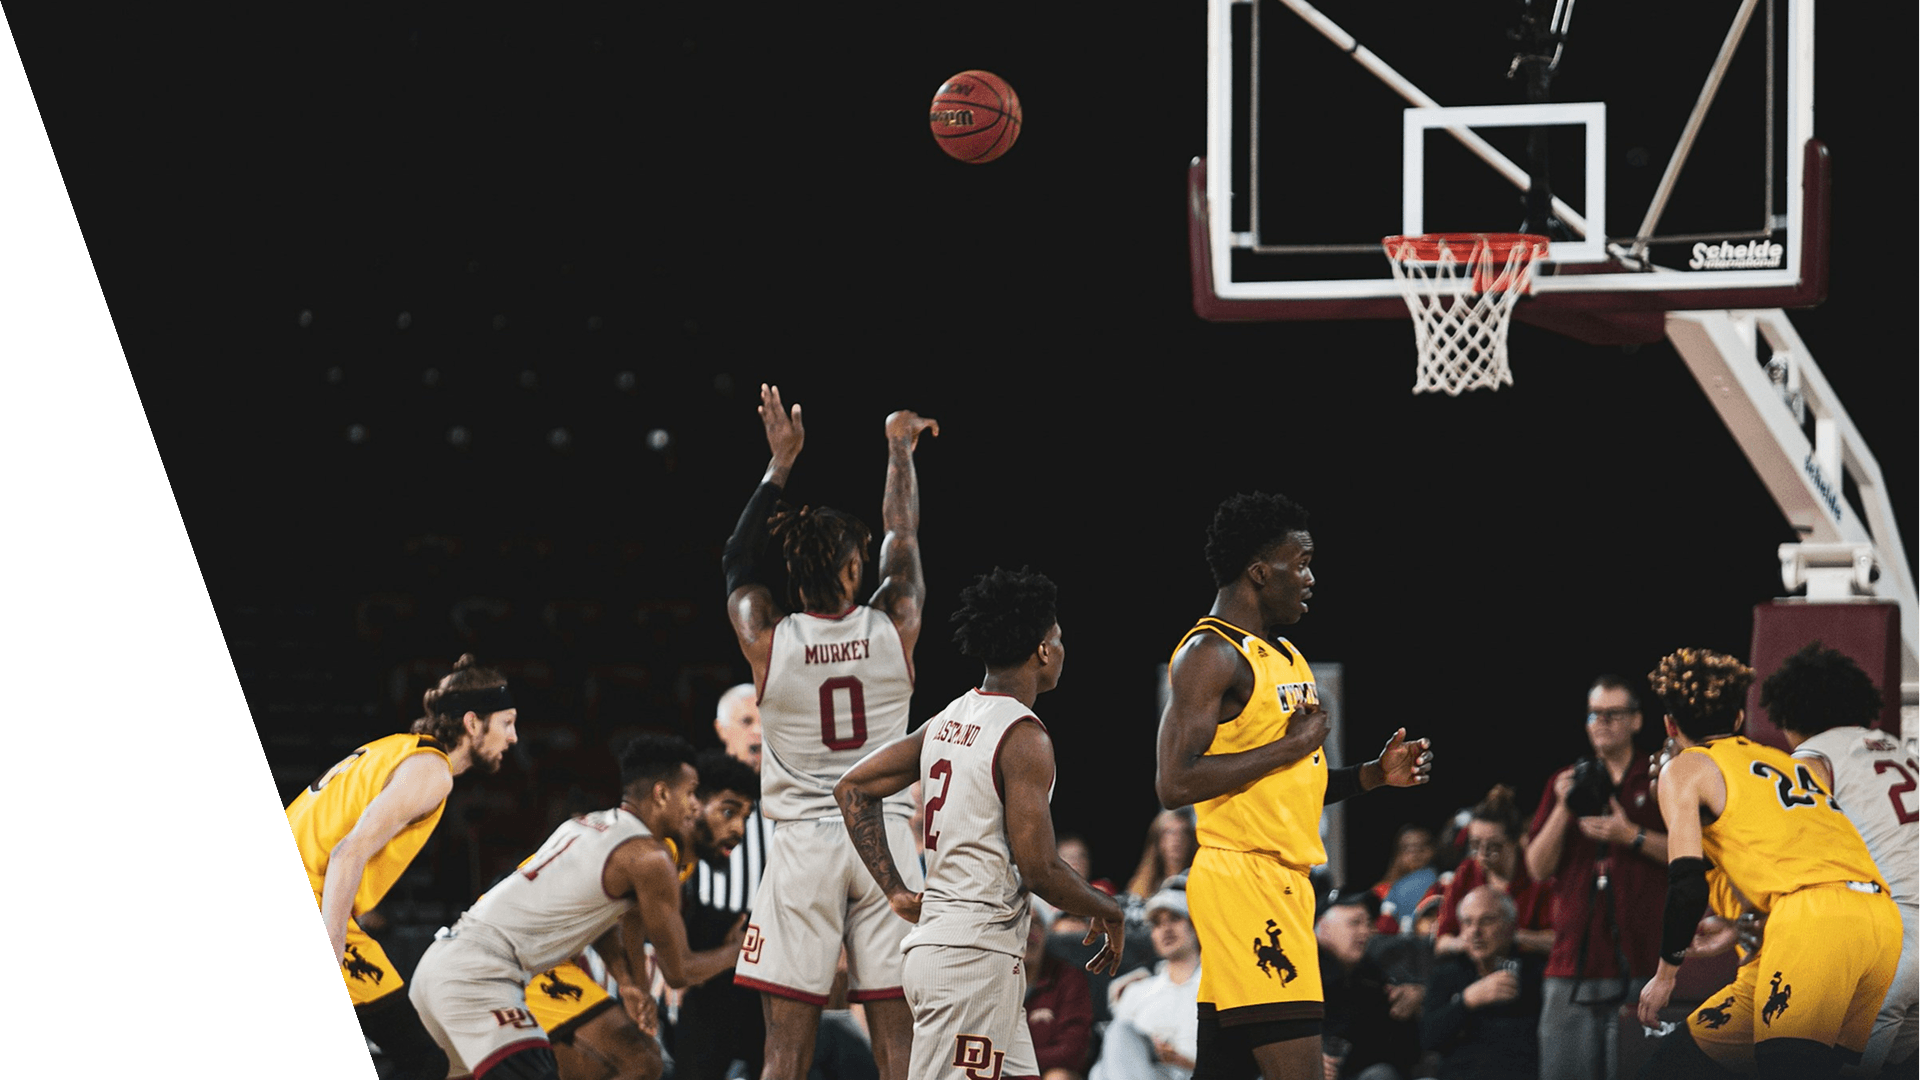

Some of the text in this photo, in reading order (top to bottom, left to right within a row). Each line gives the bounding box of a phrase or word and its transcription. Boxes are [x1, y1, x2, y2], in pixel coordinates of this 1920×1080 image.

[1689, 240, 1783, 270] Schelde
[804, 638, 870, 665] MURKEY
[819, 674, 868, 752] 0
[925, 758, 952, 851] 2
[1750, 761, 1842, 812] 24
[490, 1006, 539, 1030] DU
[953, 1033, 1006, 1080] DU
